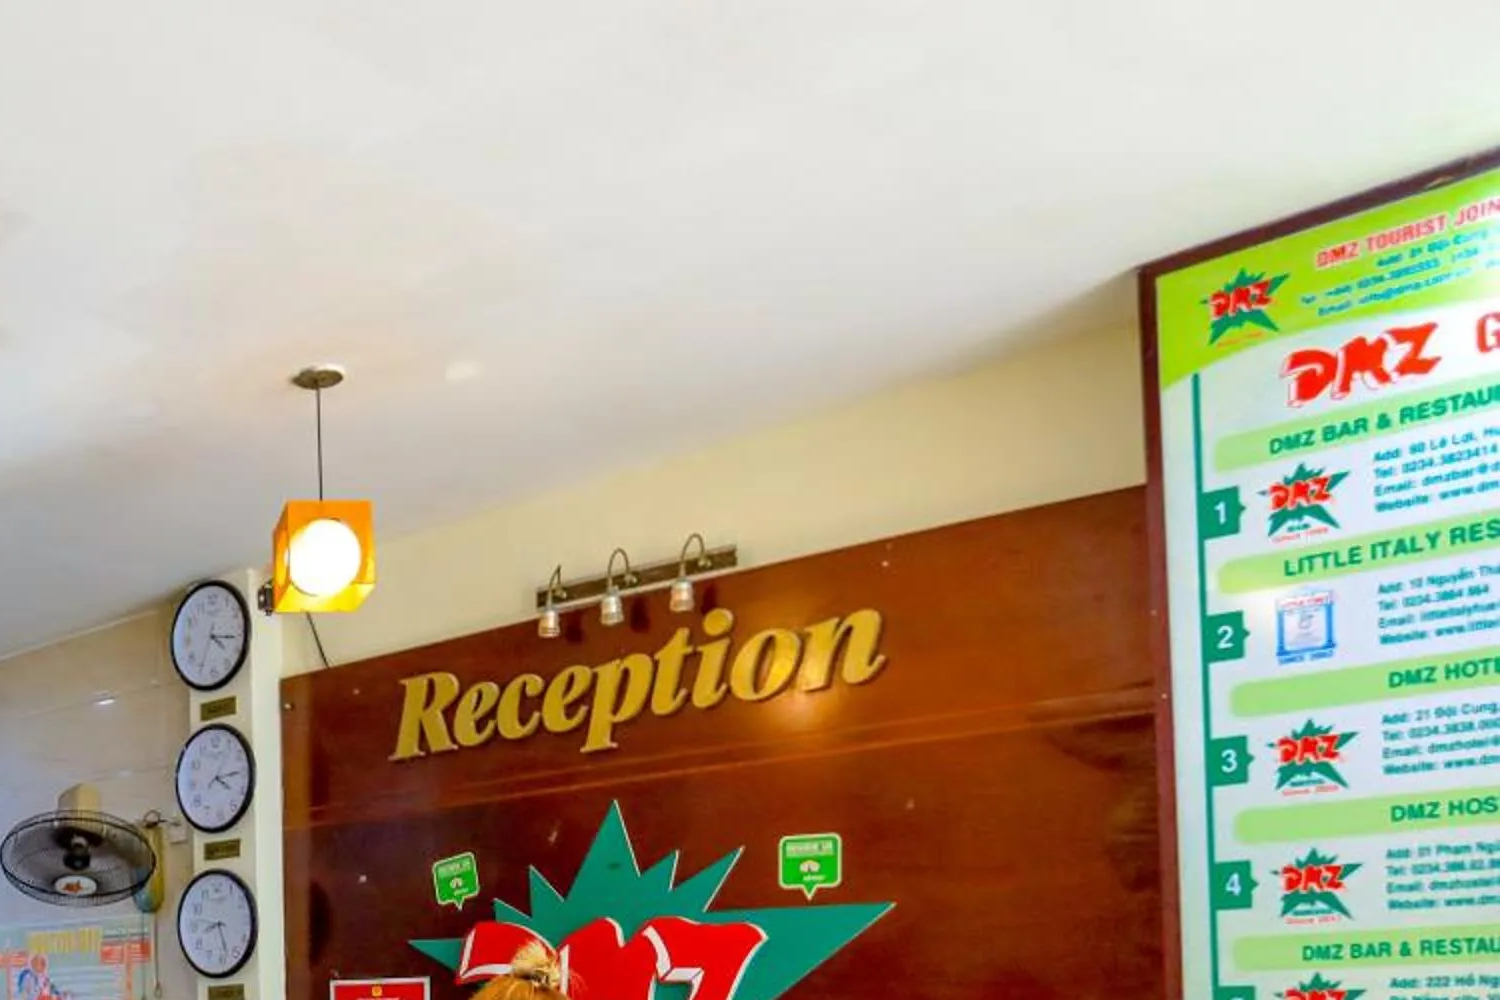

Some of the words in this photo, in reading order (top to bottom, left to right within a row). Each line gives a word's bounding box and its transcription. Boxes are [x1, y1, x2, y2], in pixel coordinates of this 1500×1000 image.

[1209, 279, 1272, 321] DMZ
[1280, 321, 1442, 408] DMZ
[1269, 429, 1316, 456] DMZ
[1322, 416, 1369, 443] BAR
[1376, 412, 1392, 431] &
[1399, 384, 1500, 424] RESTAU
[1267, 476, 1334, 511] DMZ
[1214, 502, 1228, 525] 1
[1283, 545, 1363, 577] LITTLE
[1369, 530, 1442, 561] ITALY
[1216, 626, 1235, 650] 2
[387, 606, 886, 762] Reception
[1388, 666, 1438, 689] DMZ
[1220, 749, 1238, 773] 3
[1276, 734, 1341, 764] DMZ
[1390, 801, 1441, 823] DMZ
[1447, 796, 1500, 817] HOS
[1224, 872, 1242, 897] 4
[1281, 864, 1346, 892] DMZ
[1302, 943, 1345, 963] DMZ
[1350, 941, 1393, 960] BAR
[1398, 941, 1413, 958] &
[1419, 936, 1500, 959] RESTAU
